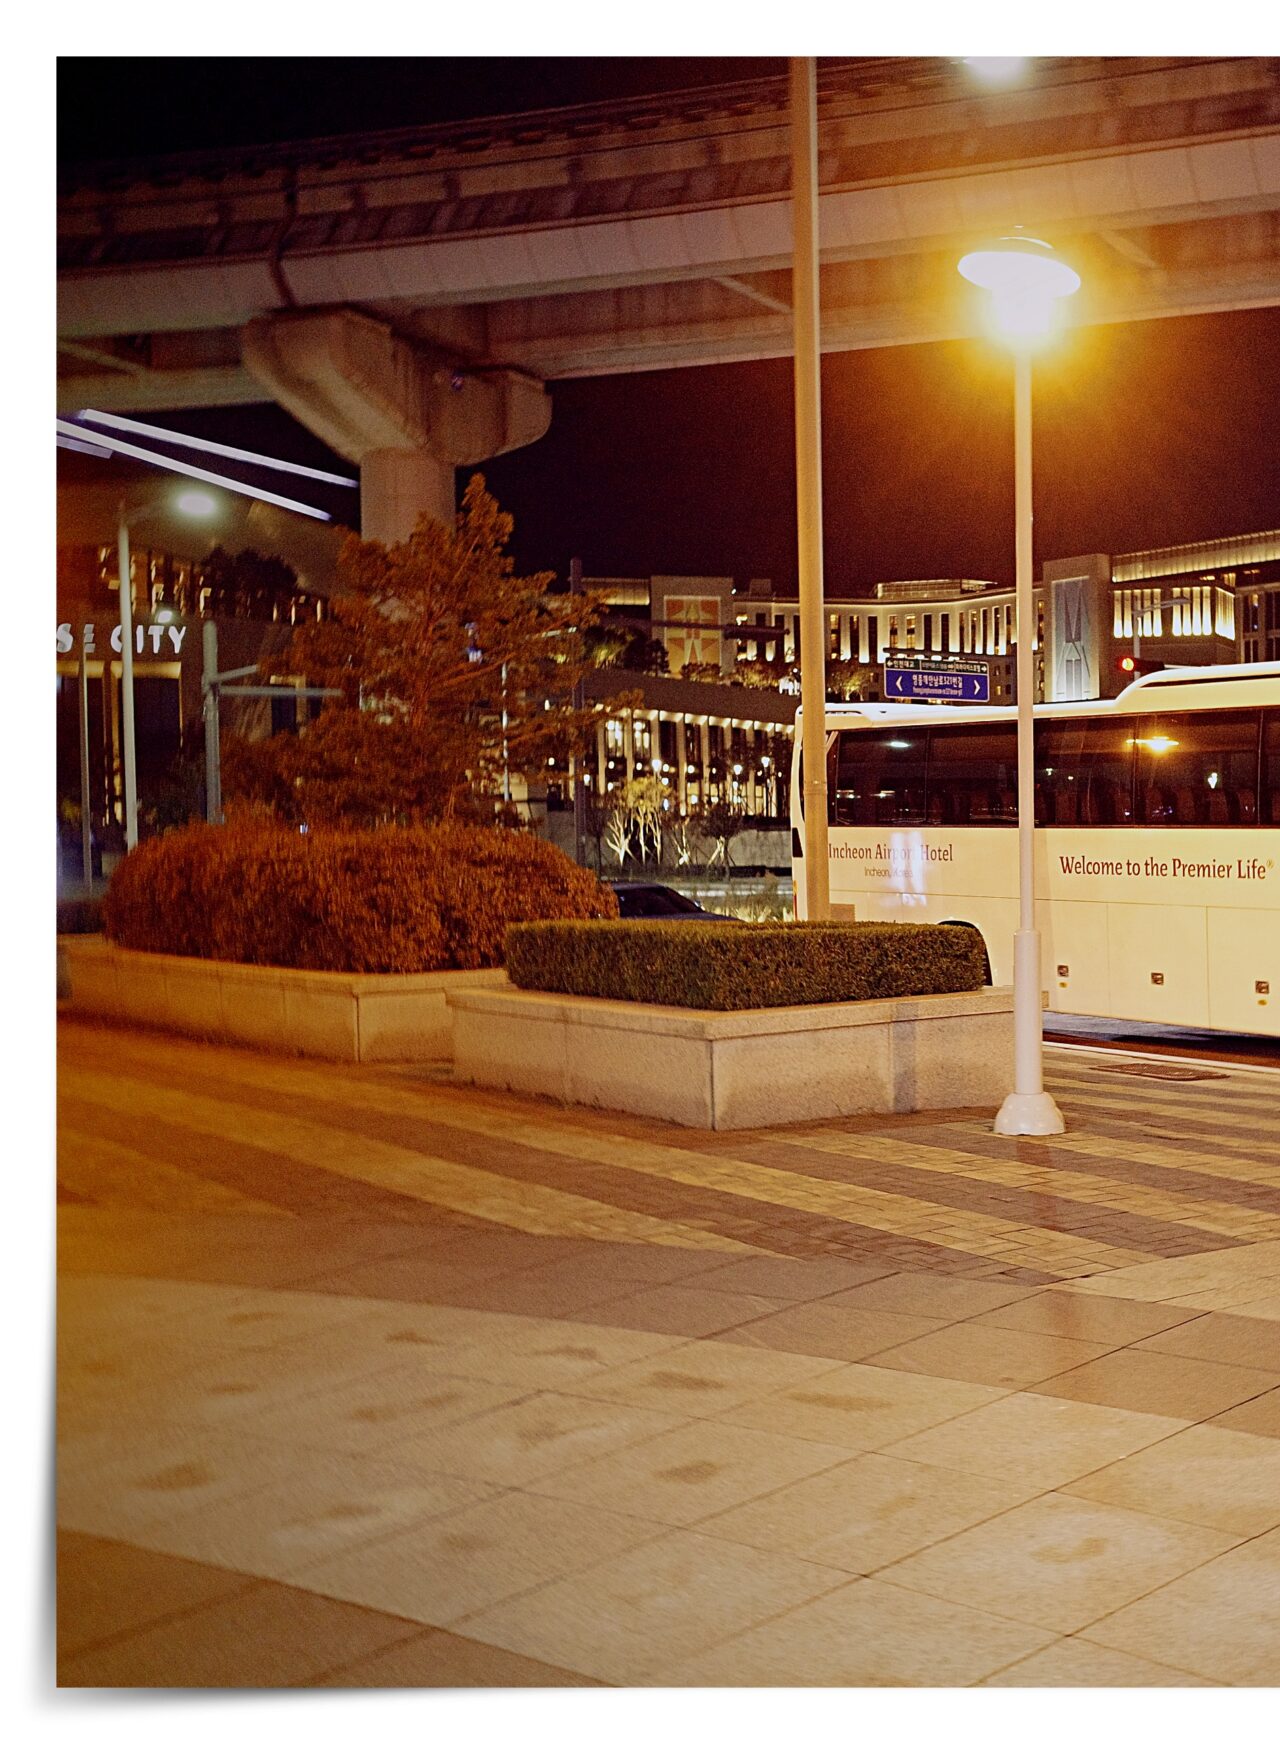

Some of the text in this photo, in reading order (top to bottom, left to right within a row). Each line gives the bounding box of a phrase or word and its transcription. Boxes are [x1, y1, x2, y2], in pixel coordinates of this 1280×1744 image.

[110, 624, 187, 655] CITY
[828, 843, 872, 860] Incheon
[921, 844, 953, 862] Hotel
[1059, 855, 1123, 876] Welcome
[1126, 858, 1141, 876] to
[1144, 856, 1168, 878] the
[1172, 858, 1233, 879] Premier
